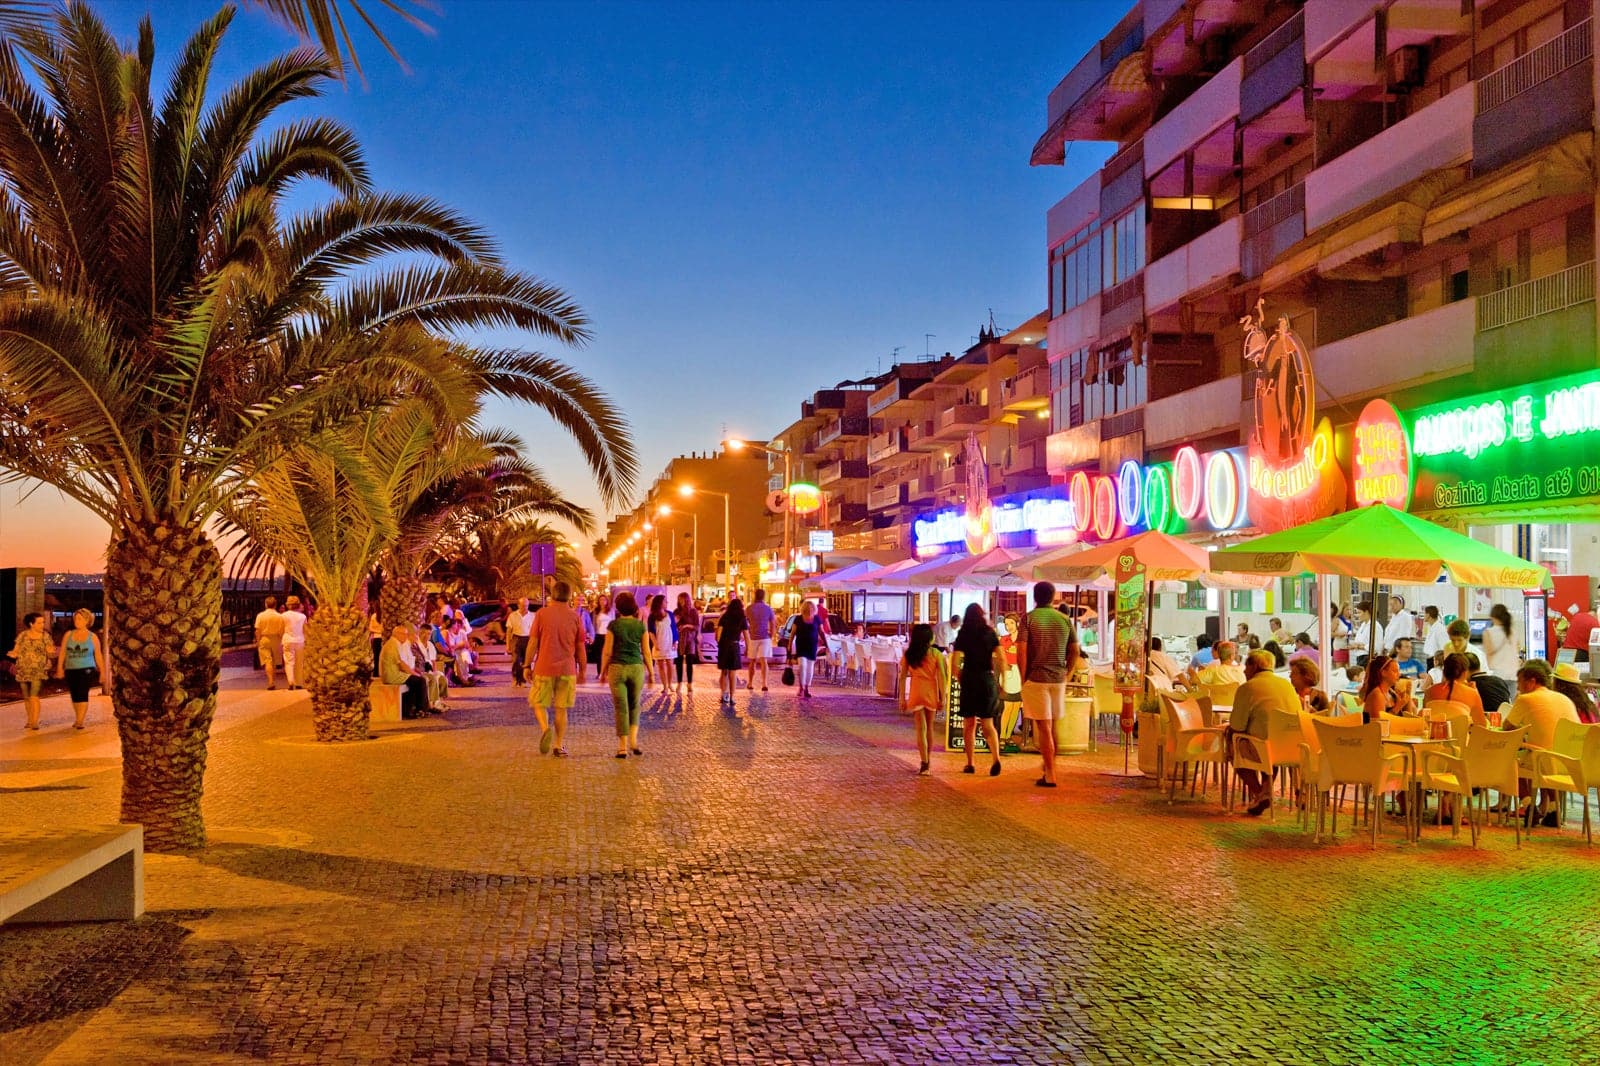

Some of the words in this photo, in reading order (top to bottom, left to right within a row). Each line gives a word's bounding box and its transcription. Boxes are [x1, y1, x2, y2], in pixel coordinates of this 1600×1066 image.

[1512, 395, 1534, 442] E
[1434, 480, 1486, 508] Cozinha
[1491, 474, 1540, 503] Aberta
[1544, 467, 1573, 498] até
[1374, 558, 1427, 577] Coca-Cola
[1500, 566, 1539, 585] Coca-Cola
